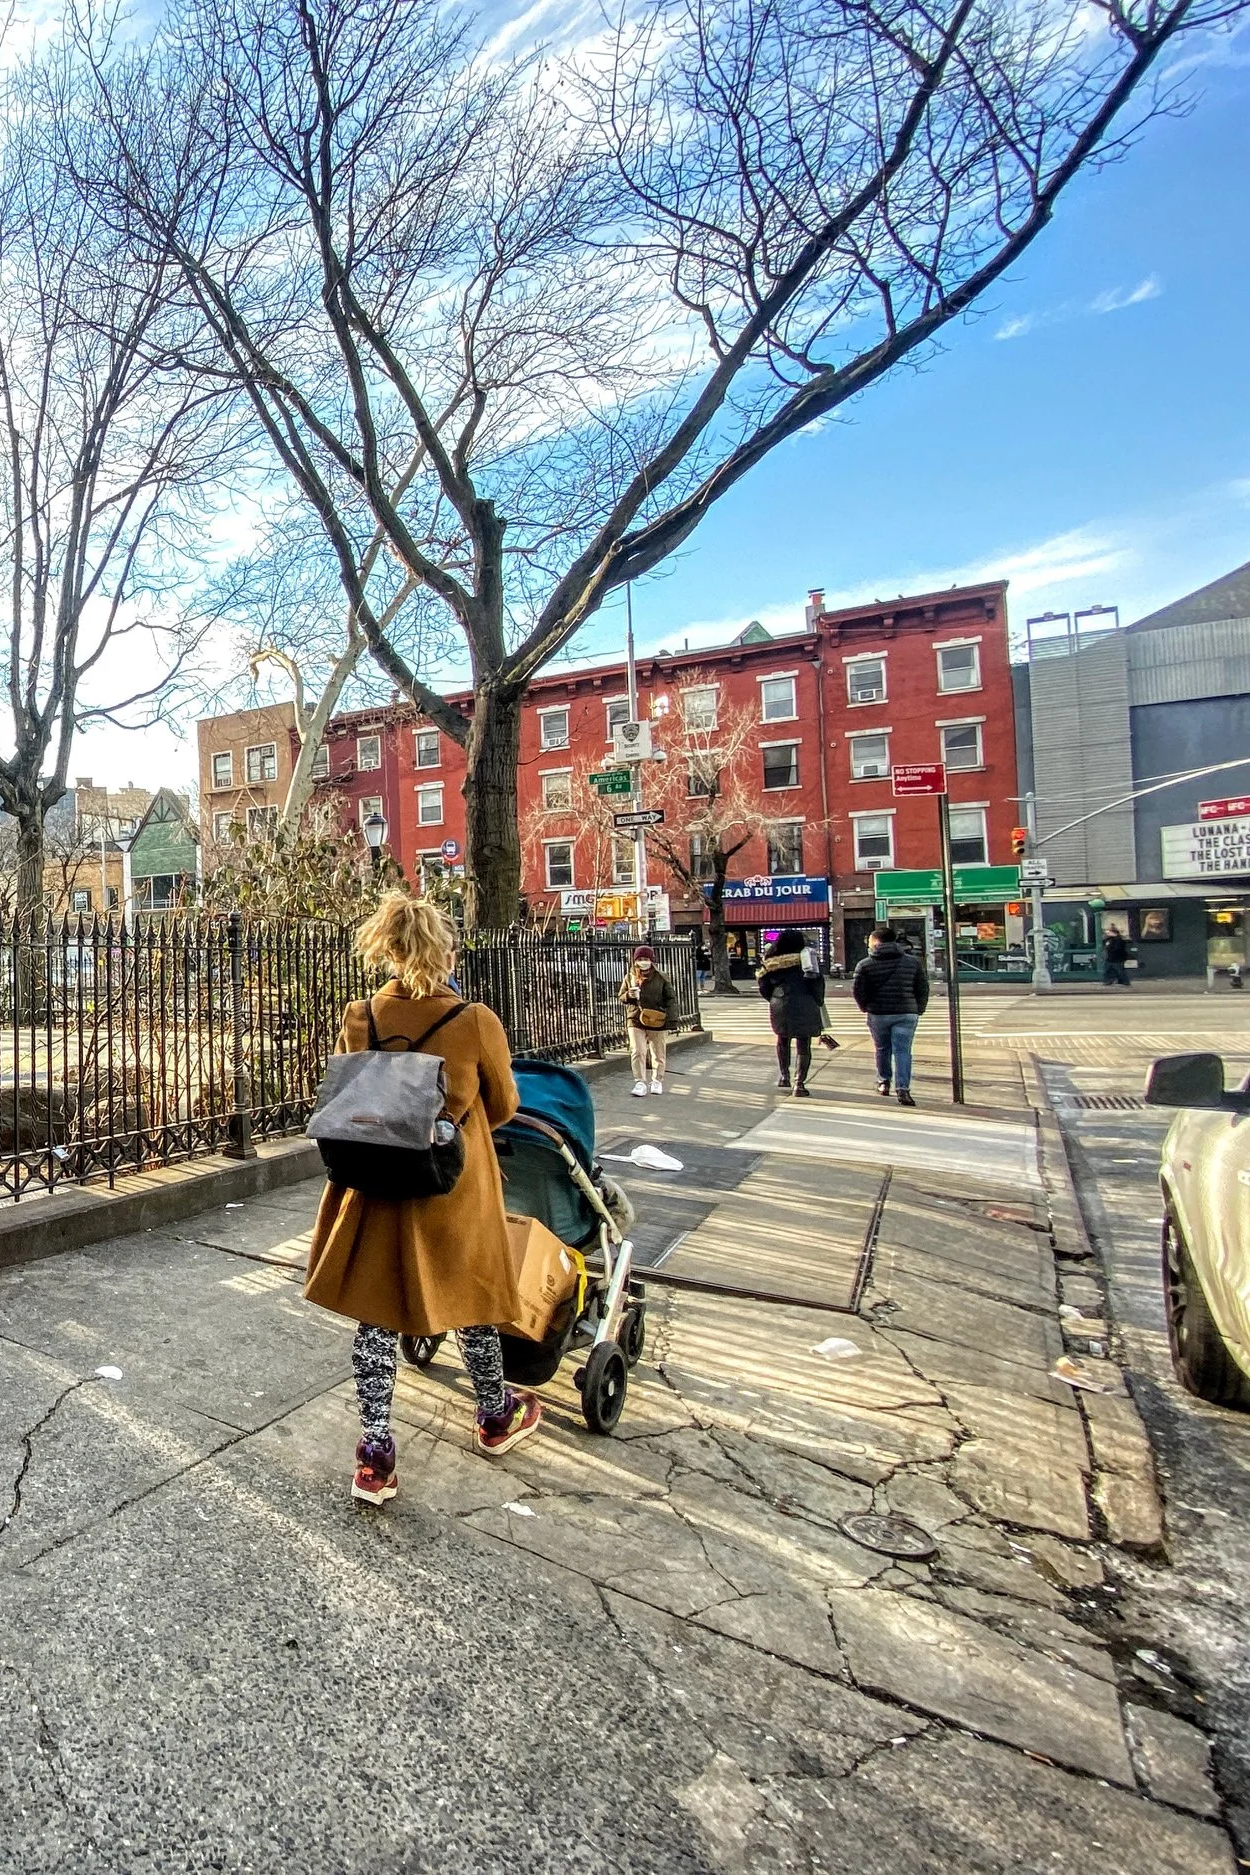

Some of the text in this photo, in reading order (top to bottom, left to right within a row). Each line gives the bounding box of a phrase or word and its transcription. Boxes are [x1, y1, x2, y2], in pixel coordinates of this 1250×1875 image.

[593, 775, 627, 784] Americas
[606, 784, 612, 793] 6
[1192, 824, 1239, 838] LUNANA
[1198, 837, 1219, 849] THE
[1190, 850, 1211, 861] THE
[1214, 847, 1243, 859] LOST
[1199, 859, 1250, 872] THE HAN
[722, 885, 812, 898] RAB DU JOUR
